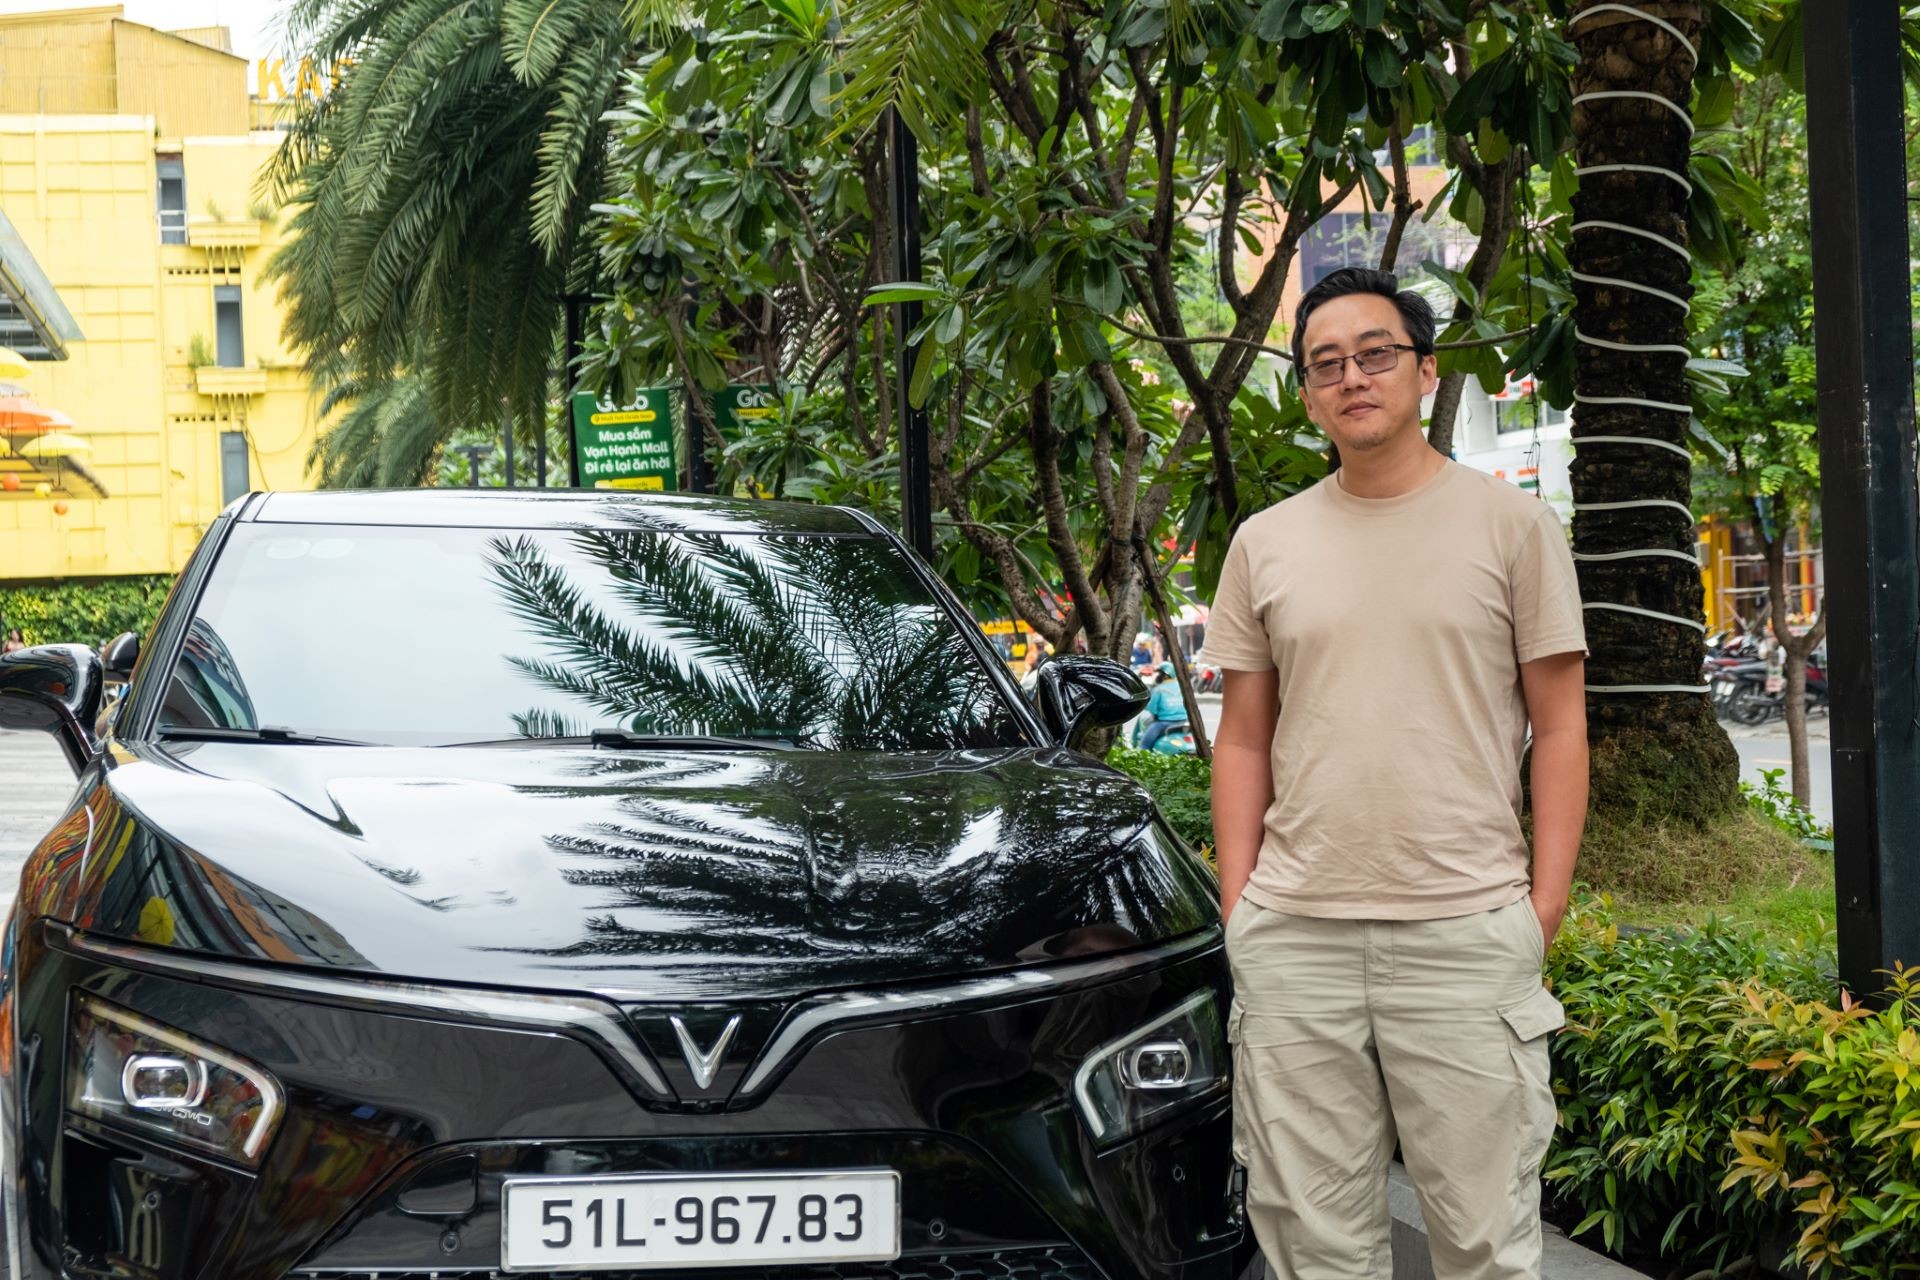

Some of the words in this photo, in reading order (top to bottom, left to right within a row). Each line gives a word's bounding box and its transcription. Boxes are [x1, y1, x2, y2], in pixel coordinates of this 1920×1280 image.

[599, 431, 626, 442] Mua
[584, 447, 607, 459] Vạn
[608, 443, 641, 458] Hạnh
[642, 441, 669, 454] Mall
[584, 461, 599, 474] Đi
[615, 459, 631, 474] lại
[541, 1193, 864, 1249] 51L-967.83
